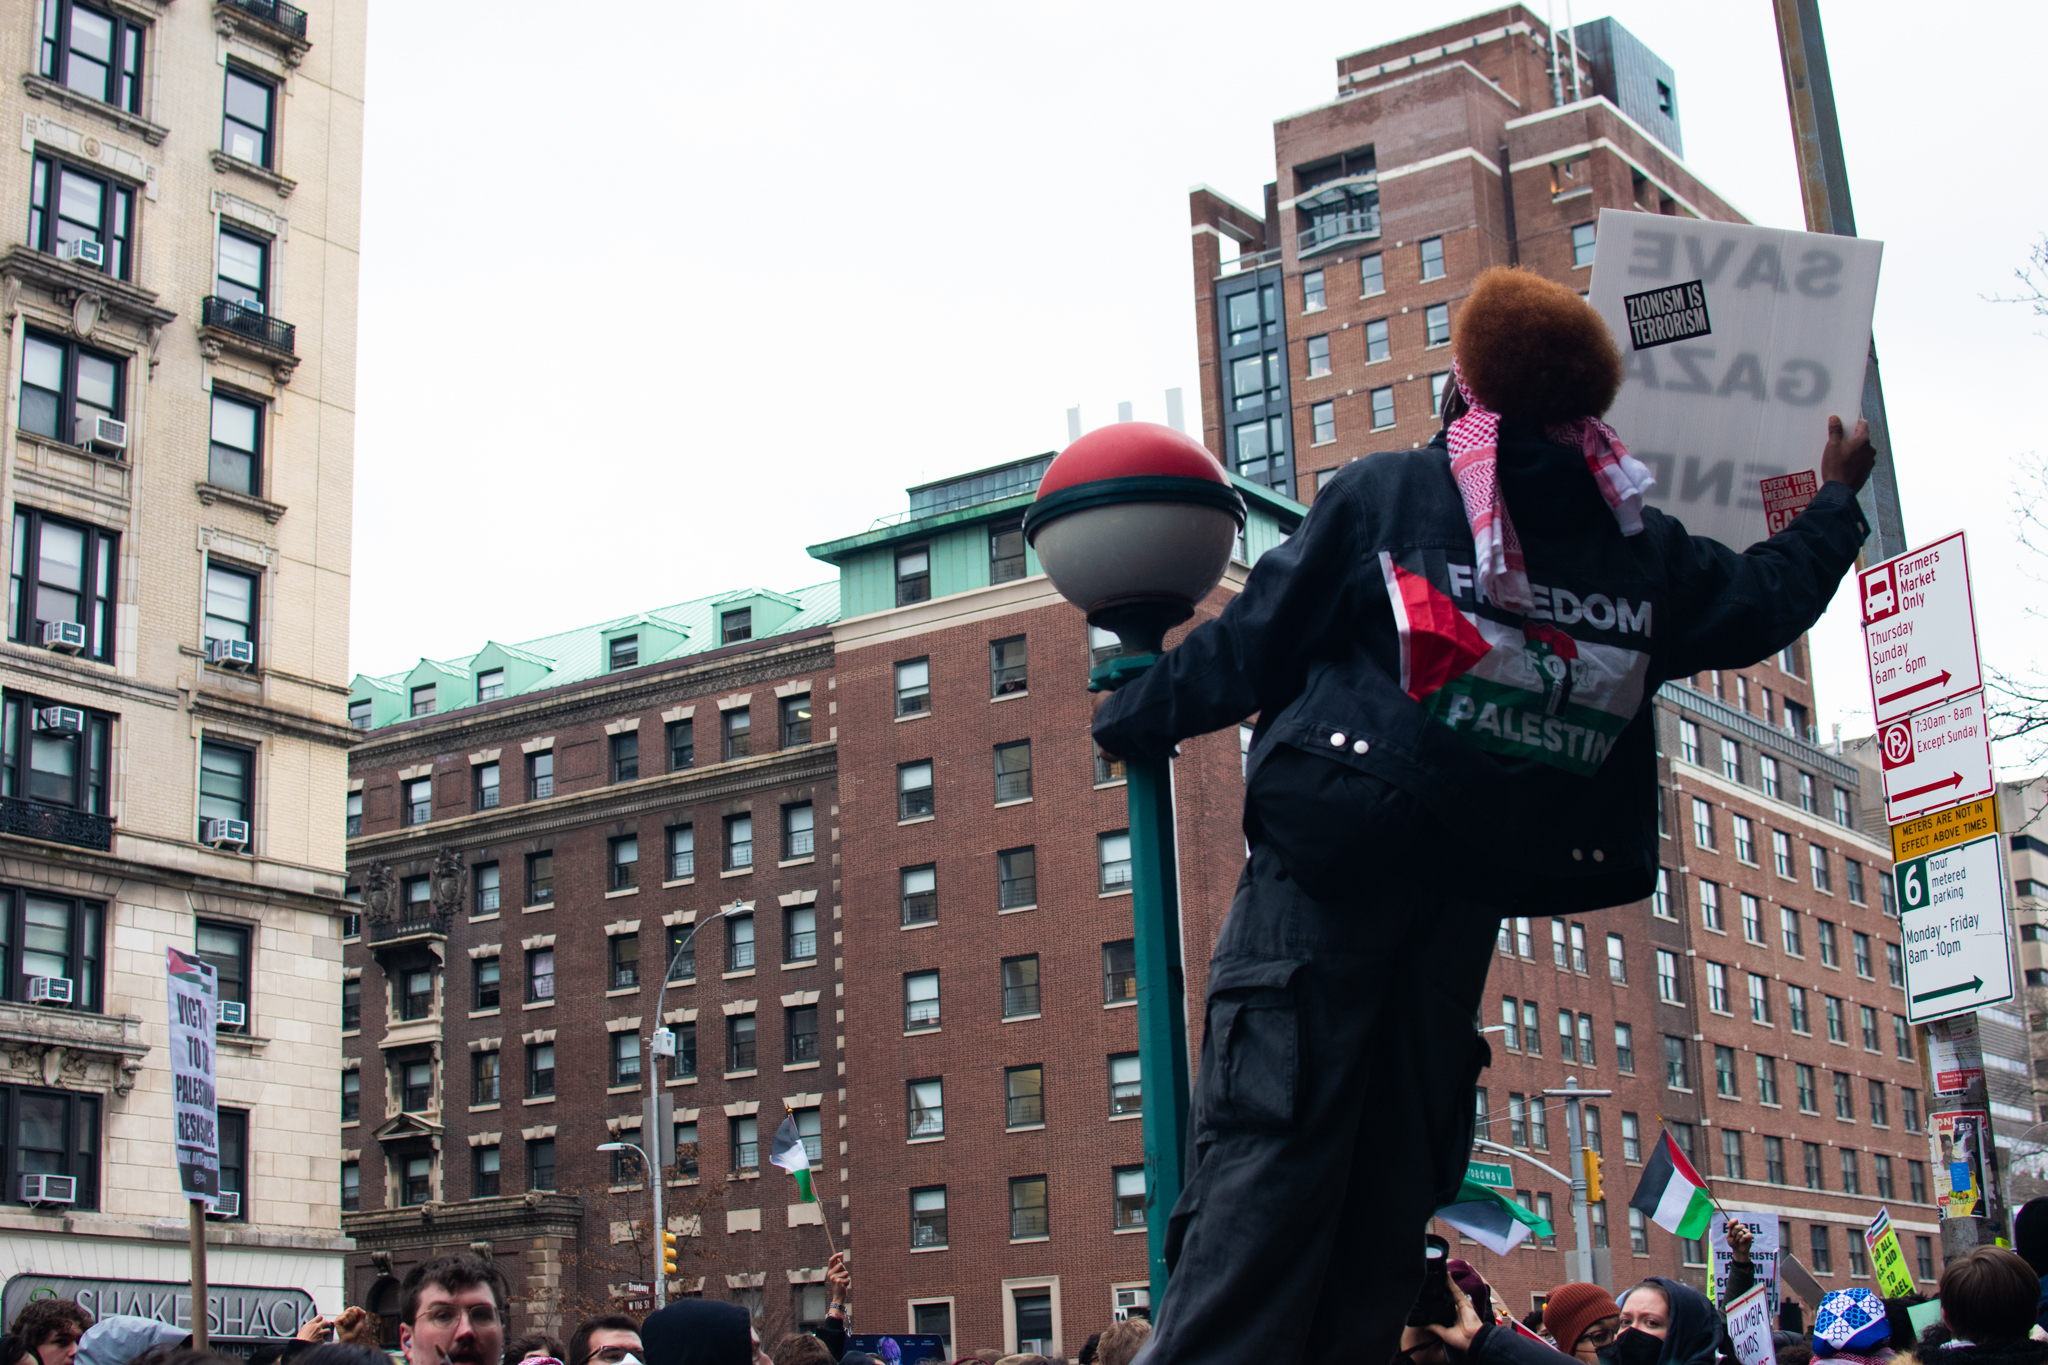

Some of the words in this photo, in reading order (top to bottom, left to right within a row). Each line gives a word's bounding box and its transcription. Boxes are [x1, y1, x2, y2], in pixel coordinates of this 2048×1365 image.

[1627, 288, 1686, 322] ZIONISM
[1686, 284, 1703, 308] IS
[1631, 307, 1708, 345] TERRORISM
[1762, 477, 1789, 492] EVERY
[1791, 472, 1814, 486] TIME
[1764, 487, 1794, 502] MEDIA
[1795, 482, 1816, 496] LIES
[1769, 506, 1806, 533] GA
[1898, 551, 1940, 578] Farmers
[1900, 568, 1936, 594] Market
[1447, 562, 1652, 637] FEDOM
[1902, 592, 1925, 611] Only
[1871, 620, 1913, 647] Thursday
[1872, 642, 1908, 666] Sunday
[1524, 651, 1589, 688] FOR
[1875, 667, 1896, 685] 6am
[1905, 655, 1927, 674] 6pm
[1915, 714, 1946, 733] 7:30am
[1953, 706, 1973, 721] 8am
[1917, 733, 1946, 753] Except
[1947, 724, 1978, 743] Sunday
[1902, 818, 1933, 837] METERS
[1936, 812, 1953, 827] ARE
[1955, 806, 1971, 821] NOT
[1974, 802, 1983, 814] IN
[1901, 835, 1929, 853] EFFECT
[1933, 826, 1961, 843] ABOVE
[1963, 817, 1988, 834] TIMES
[1929, 857, 1948, 872] hour
[1932, 866, 1966, 888] metered
[1904, 864, 1922, 906] 6
[1933, 886, 1964, 906] parking
[1906, 924, 1941, 945] Monday
[1950, 914, 1979, 933] Friday
[1908, 948, 1928, 964] 8am
[1936, 939, 1962, 957] 10pm
[186, 1035, 201, 1069] TO
[1467, 1168, 1502, 1184] roadway
[1716, 1251, 1774, 1260] TERRISTS
[1881, 1236, 1893, 1254] ALL
[1885, 1249, 1897, 1268] AID
[629, 1282, 649, 1294] Broadway
[1886, 1271, 1896, 1286] TO
[76, 1289, 193, 1333] SHAKE
[207, 1295, 315, 1337] SHACK
[634, 1301, 643, 1310] 116
[1730, 1303, 1764, 1340] COLUMBIA
